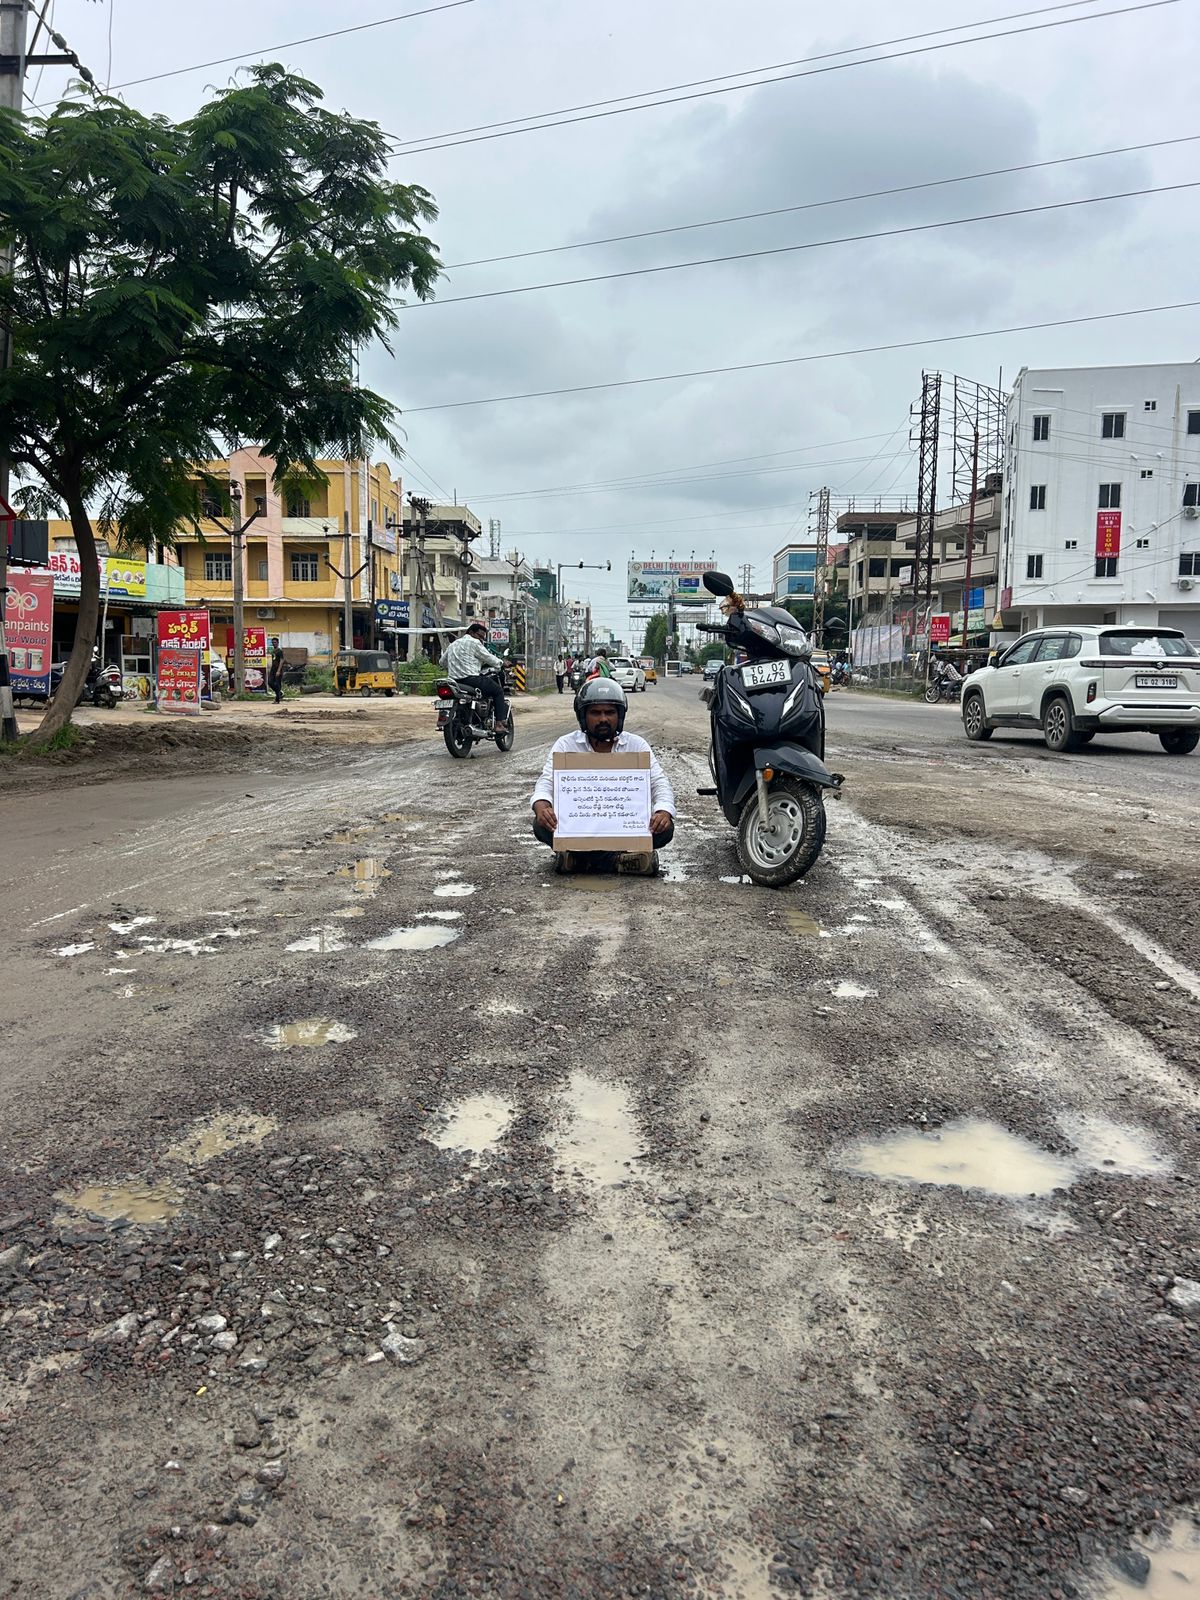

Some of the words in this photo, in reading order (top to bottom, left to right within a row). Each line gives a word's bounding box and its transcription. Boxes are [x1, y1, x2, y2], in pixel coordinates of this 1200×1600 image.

[4, 618, 49, 634] anpaints
[21, 636, 47, 645] World
[751, 665, 764, 675] TG
[771, 661, 784, 672] 02
[751, 671, 786, 685] B4479
[1150, 678, 1159, 686] 02
